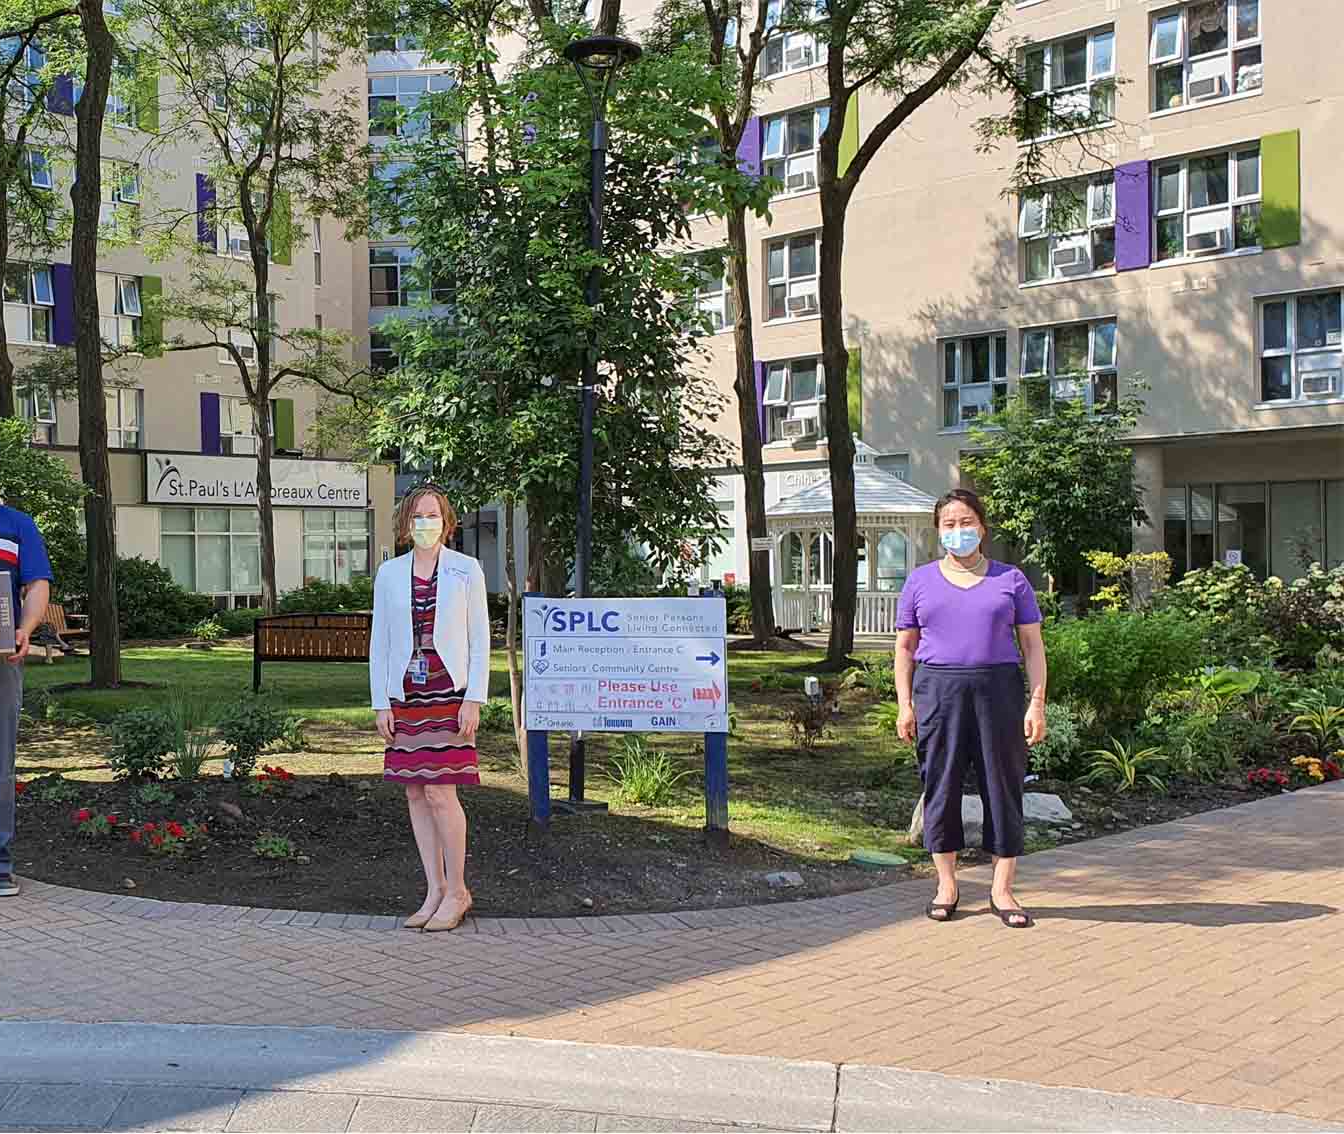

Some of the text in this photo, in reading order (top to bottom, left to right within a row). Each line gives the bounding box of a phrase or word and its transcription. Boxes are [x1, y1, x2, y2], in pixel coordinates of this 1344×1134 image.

[317, 483, 361, 501] Centre
[552, 610, 620, 632] SPLC
[627, 624, 658, 633] Living
[552, 644, 575, 654] Main
[632, 644, 674, 654] Entrance
[592, 663, 645, 675] Community
[647, 663, 680, 673] Centre
[597, 679, 679, 693] Please Use
[597, 696, 663, 709] Entrance
[651, 716, 677, 727] GAIN
